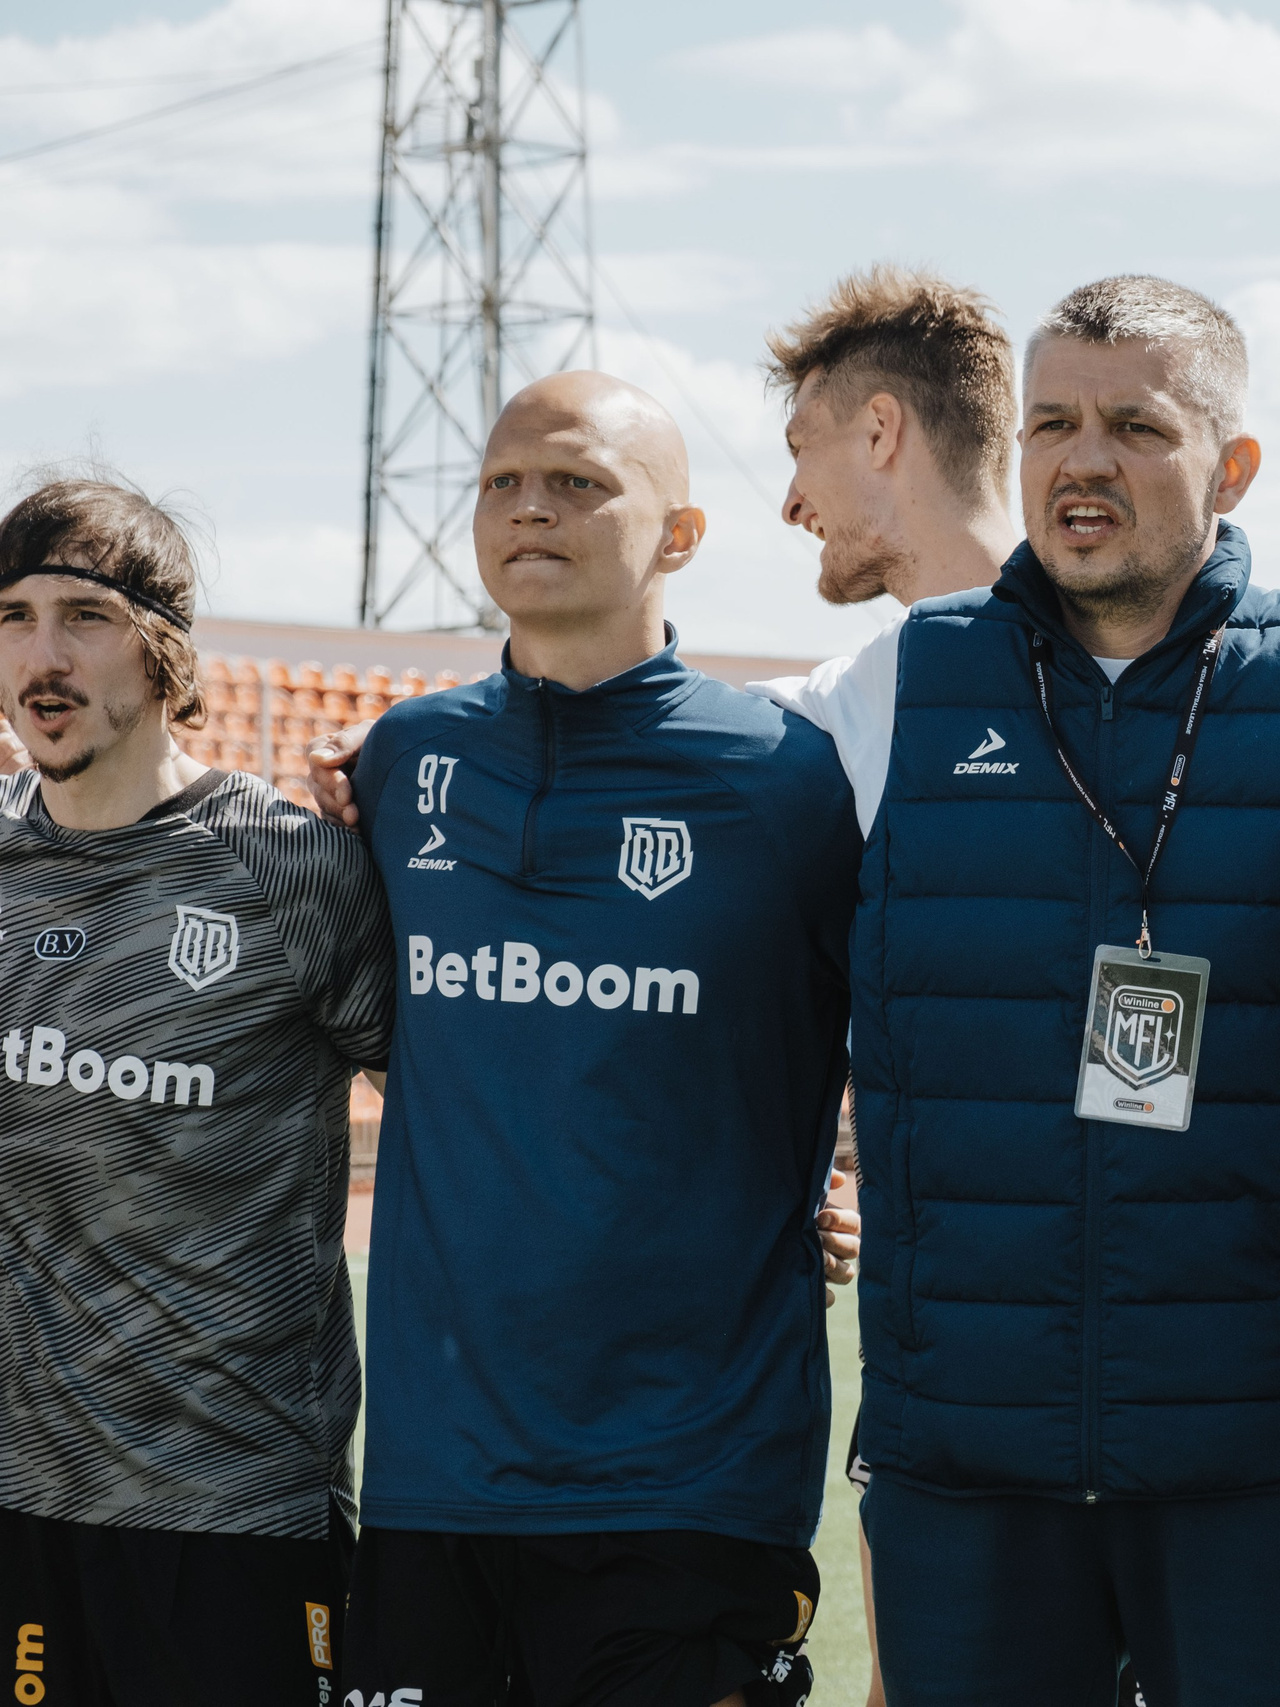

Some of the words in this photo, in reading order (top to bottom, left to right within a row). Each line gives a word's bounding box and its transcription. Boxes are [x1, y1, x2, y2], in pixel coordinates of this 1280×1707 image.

[953, 762, 1020, 775] DEMIX
[417, 754, 460, 814] 97
[1162, 791, 1178, 811] MFL
[408, 857, 458, 871] DEMIX
[409, 935, 700, 1014] BetBoom
[1123, 996, 1160, 1009] Winline
[1112, 1010, 1171, 1077] MFL
[1117, 1101, 1143, 1111] Winline
[311, 1607, 330, 1665] PRO
